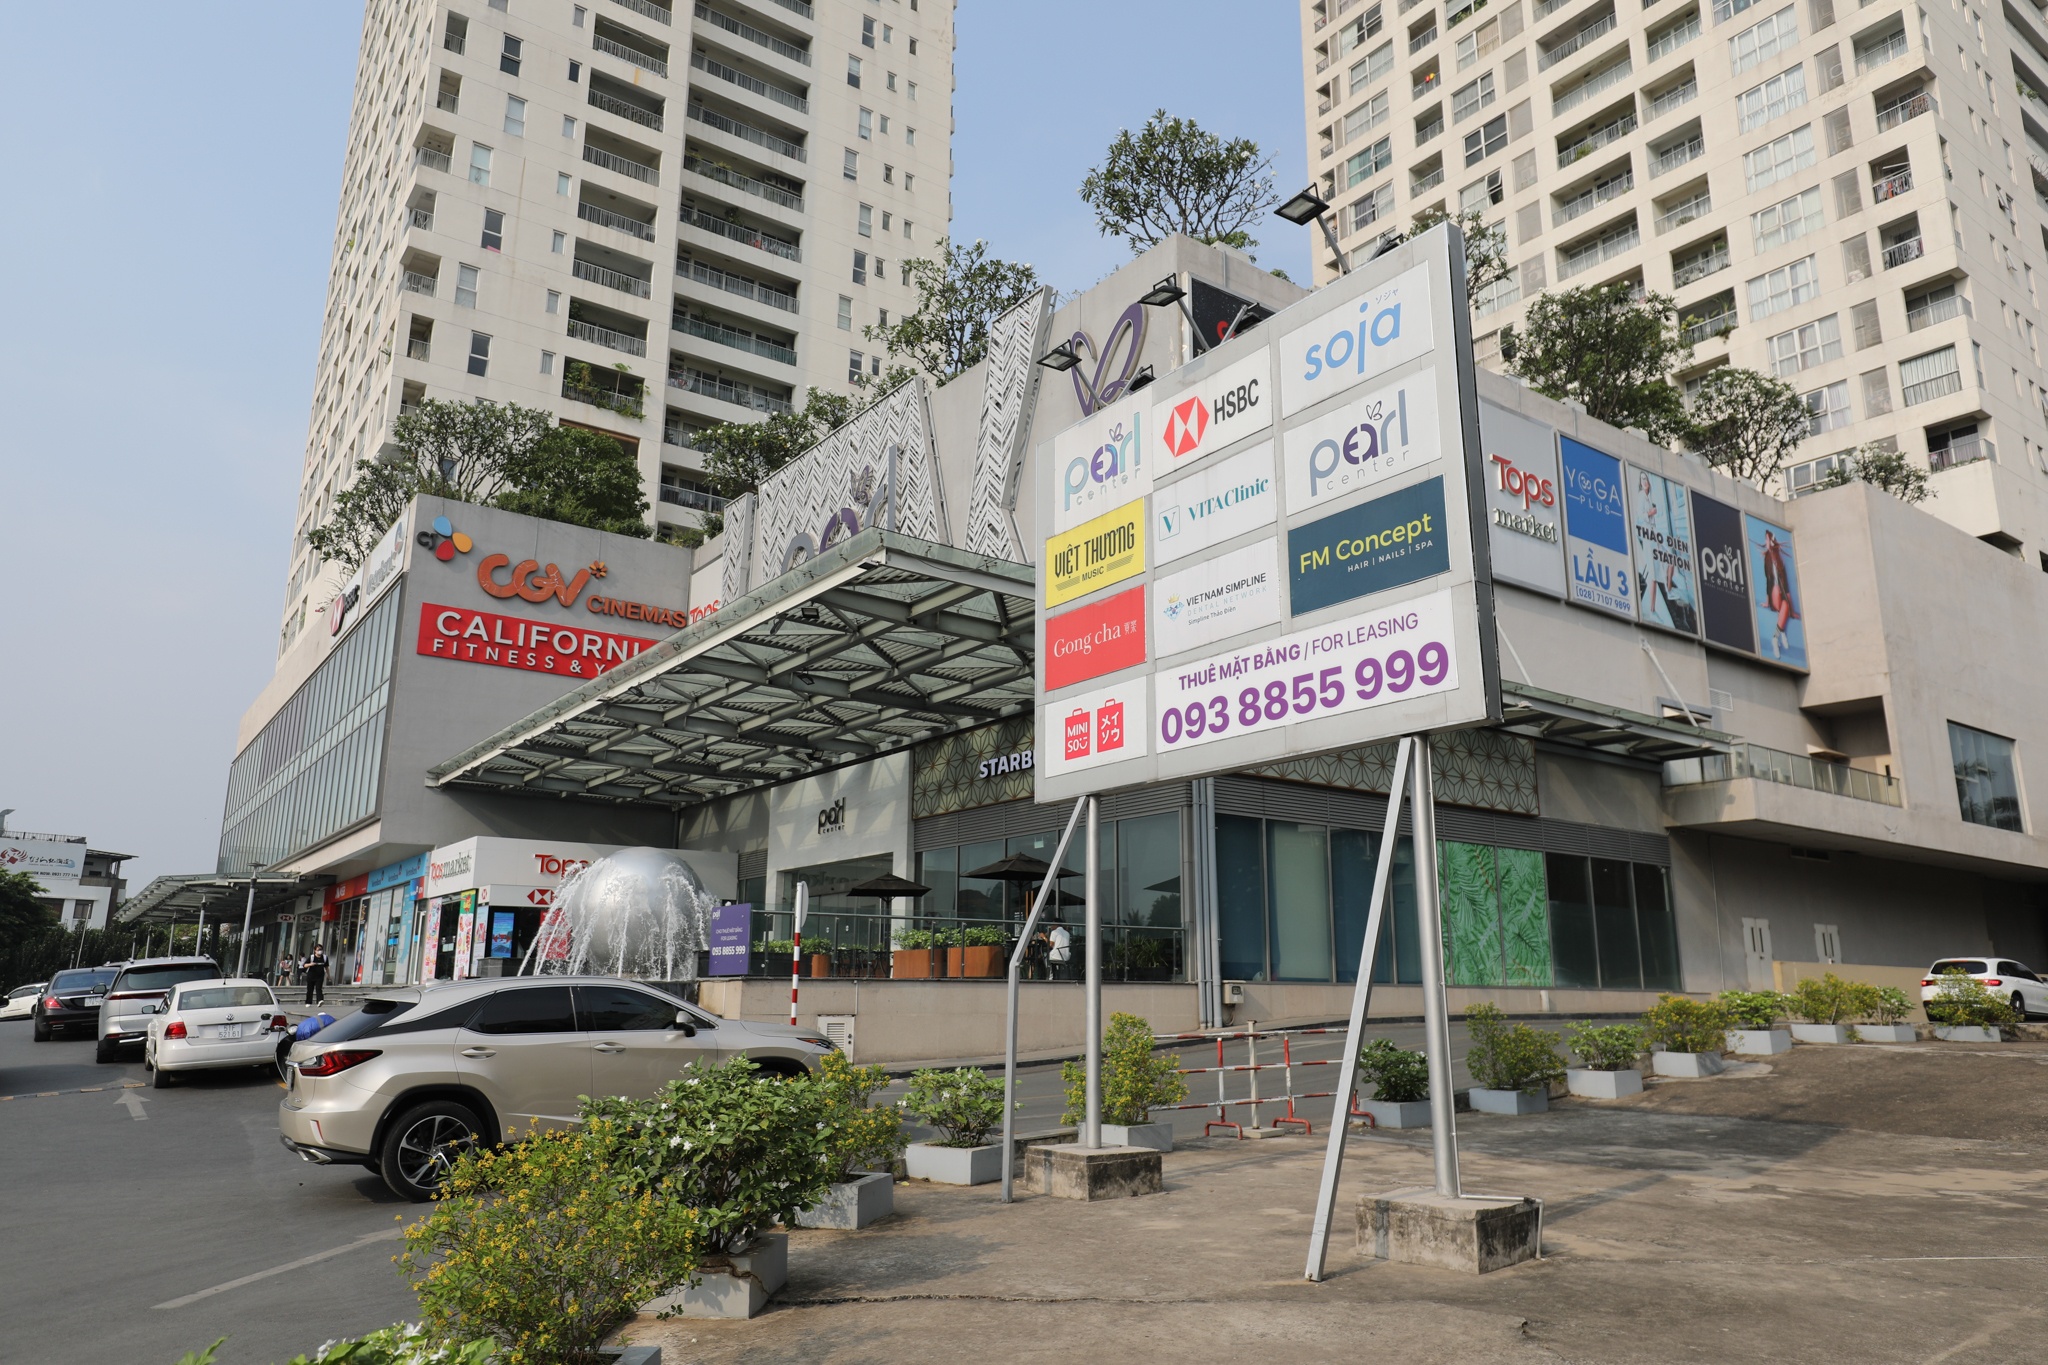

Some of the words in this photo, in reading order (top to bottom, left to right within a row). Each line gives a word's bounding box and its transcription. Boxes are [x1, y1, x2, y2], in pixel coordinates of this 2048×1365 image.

[1375, 288, 1400, 305] ソジャ
[1304, 302, 1401, 381] soja
[1213, 378, 1260, 425] HSBC
[1309, 389, 1409, 497] pearl
[1064, 411, 1141, 511] pearl
[1326, 448, 1411, 491] center
[1075, 467, 1140, 506] center
[1188, 478, 1270, 521] VITAClinic
[1489, 454, 1555, 511] Tops
[1579, 496, 1610, 516] PLUS
[416, 530, 438, 551] CJ
[1300, 545, 1330, 574] FM
[1335, 513, 1433, 561] Concept
[1492, 508, 1558, 544] market
[1054, 540, 1080, 579] VIỆT
[1081, 521, 1135, 565] THƯƠNG
[1347, 558, 1369, 573] HAIR
[1378, 548, 1406, 564] NAILS
[1415, 539, 1434, 552] SPA
[1652, 548, 1691, 570] STATION
[1701, 546, 1745, 586] pearl
[477, 553, 590, 607] CGV
[1082, 565, 1105, 583] MUSIC
[1186, 587, 1224, 606] VIETNAM
[1225, 572, 1267, 594] SIMPLINE
[1573, 547, 1610, 591] LẦU
[1617, 570, 1629, 597] 3
[1710, 576, 1745, 593] center
[586, 595, 688, 628] CINEMAS
[1188, 601, 1220, 617] DENTAL
[1223, 585, 1268, 605] NETWORK
[1597, 593, 1613, 607] 7107
[1614, 598, 1631, 612] 9899
[436, 611, 639, 662] CALIFORNI
[1188, 614, 1210, 626] Simpline
[433, 639, 555, 669] FITNESS
[569, 658, 582, 674] &
[1053, 632, 1092, 658] Gong
[1094, 622, 1121, 645] cha
[1178, 663, 1217, 691] THUÊ
[1218, 653, 1251, 682] MẶT
[1253, 634, 1301, 672] BẰNG
[1312, 633, 1344, 656] FOR
[1347, 612, 1419, 648] LEASING
[1161, 695, 1230, 744] 093
[1238, 666, 1345, 728] 8855
[1355, 641, 1449, 700] 999
[1067, 721, 1088, 738] MINI
[1100, 711, 1120, 730] メイ
[1101, 729, 1121, 745] ソウ
[978, 750, 1034, 778] STARB
[712, 947, 722, 956] 093
[722, 946, 735, 956] 8855
[735, 945, 746, 955] 999
